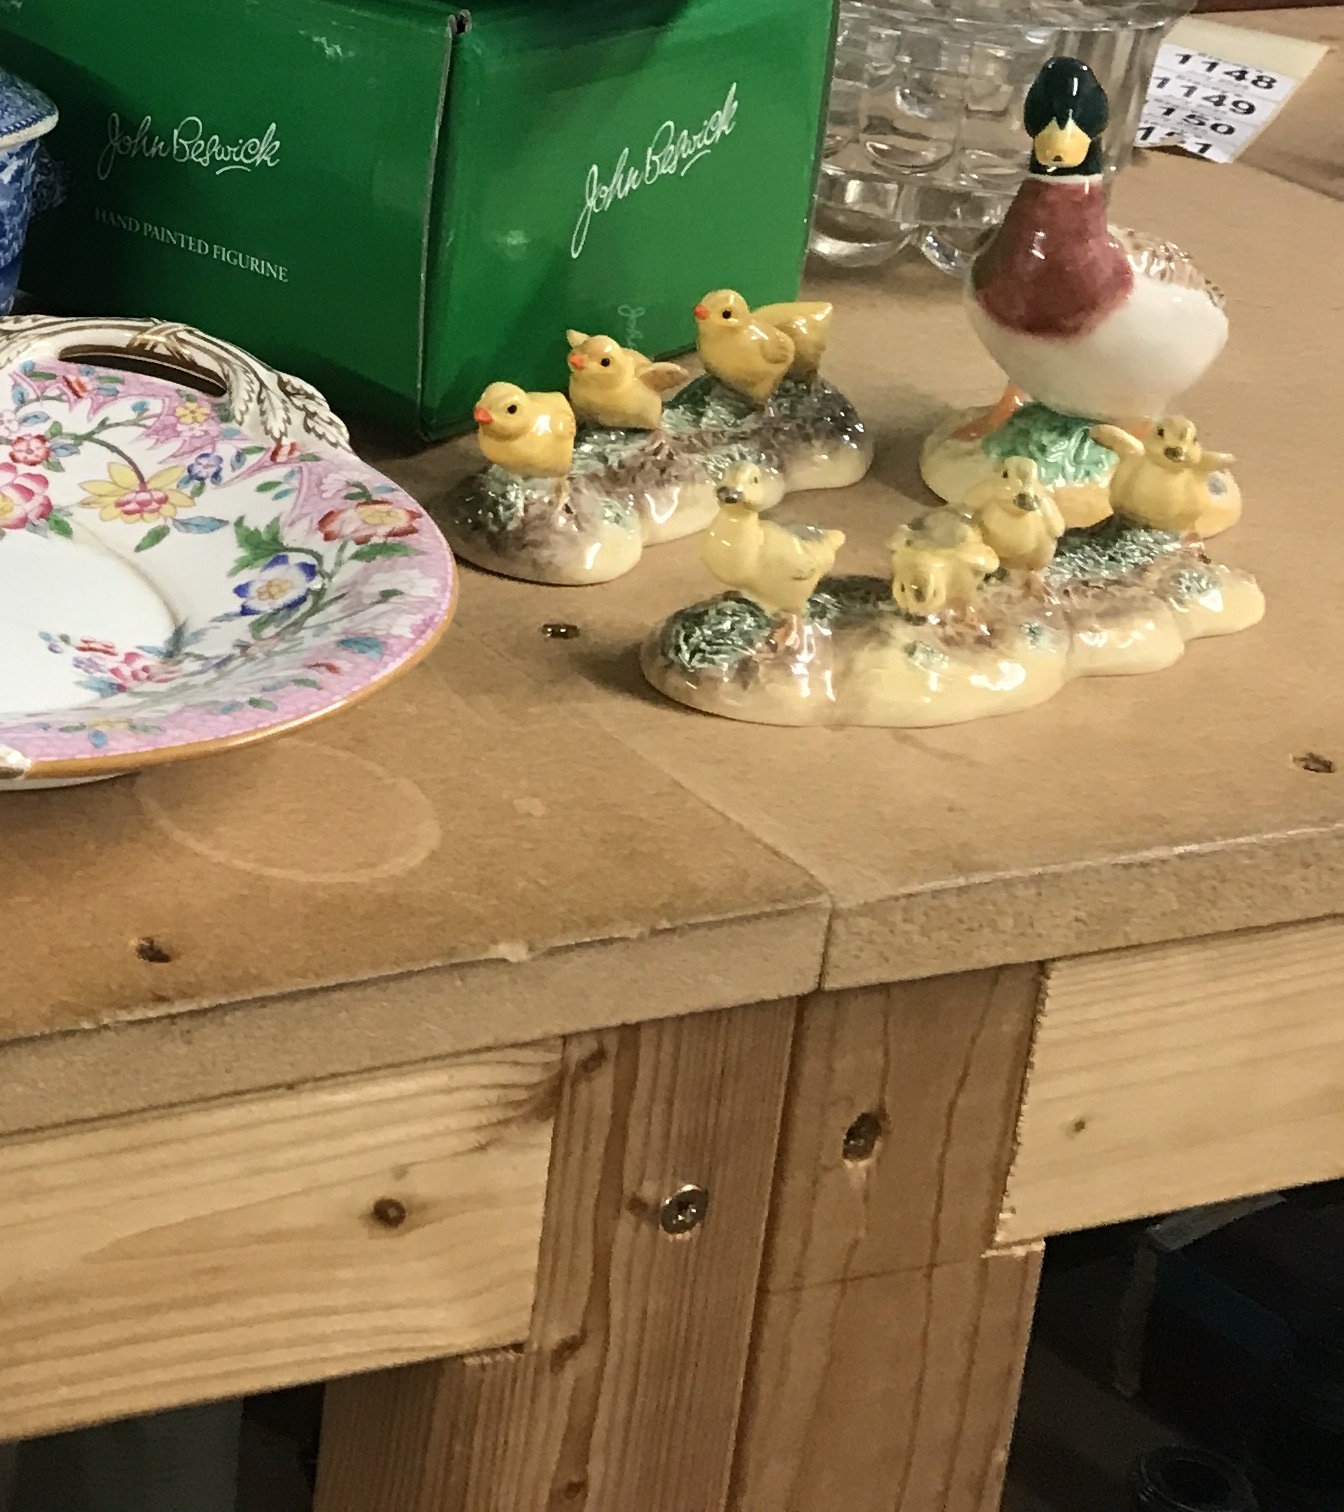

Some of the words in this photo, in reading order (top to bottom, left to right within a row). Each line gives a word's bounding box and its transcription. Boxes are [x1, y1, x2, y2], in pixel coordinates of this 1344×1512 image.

[1153, 76, 1256, 116] 1149
[1175, 52, 1277, 90] 1148
[97, 112, 171, 181] John
[172, 115, 281, 176] Beswick
[570, 146, 644, 260] John
[643, 81, 739, 185] Beswick
[94, 205, 141, 234] HAND
[142, 221, 210, 256] PAINTED
[212, 244, 289, 283] FIGURINE
